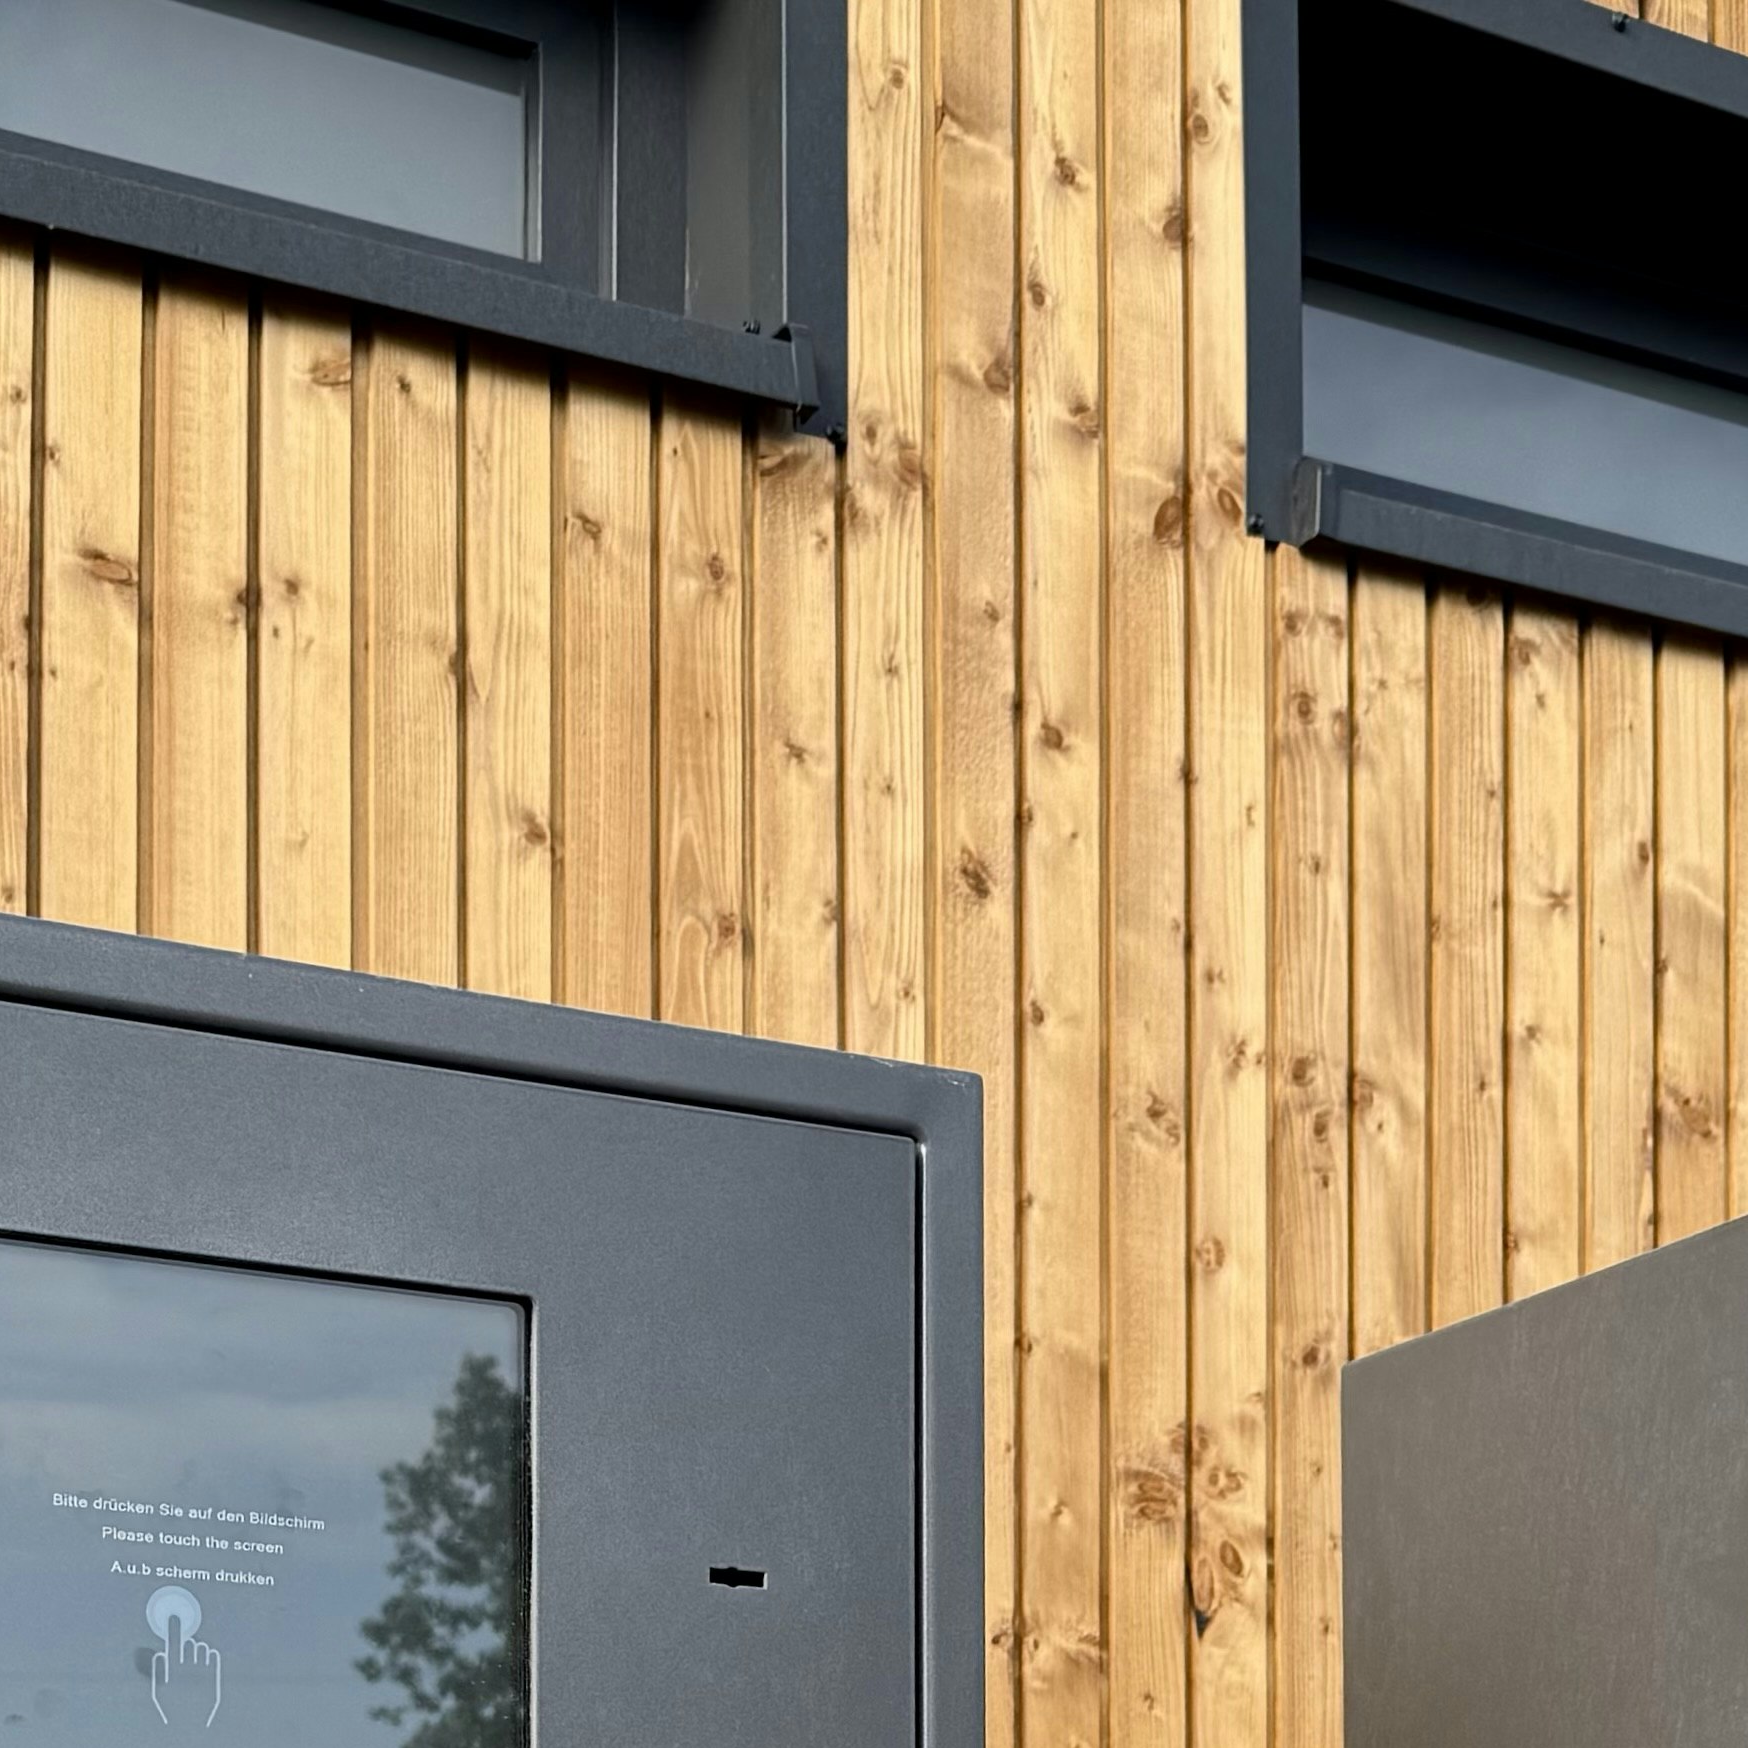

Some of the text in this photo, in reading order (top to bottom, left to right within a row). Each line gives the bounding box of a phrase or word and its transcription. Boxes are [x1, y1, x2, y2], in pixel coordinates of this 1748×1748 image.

[53, 1493, 325, 1530] Bitte drücken Sie auf den Bildschirm
[102, 1526, 284, 1554] Please touch the screen
[156, 1565, 210, 1581] scherm
[216, 1569, 274, 1586] drukken
